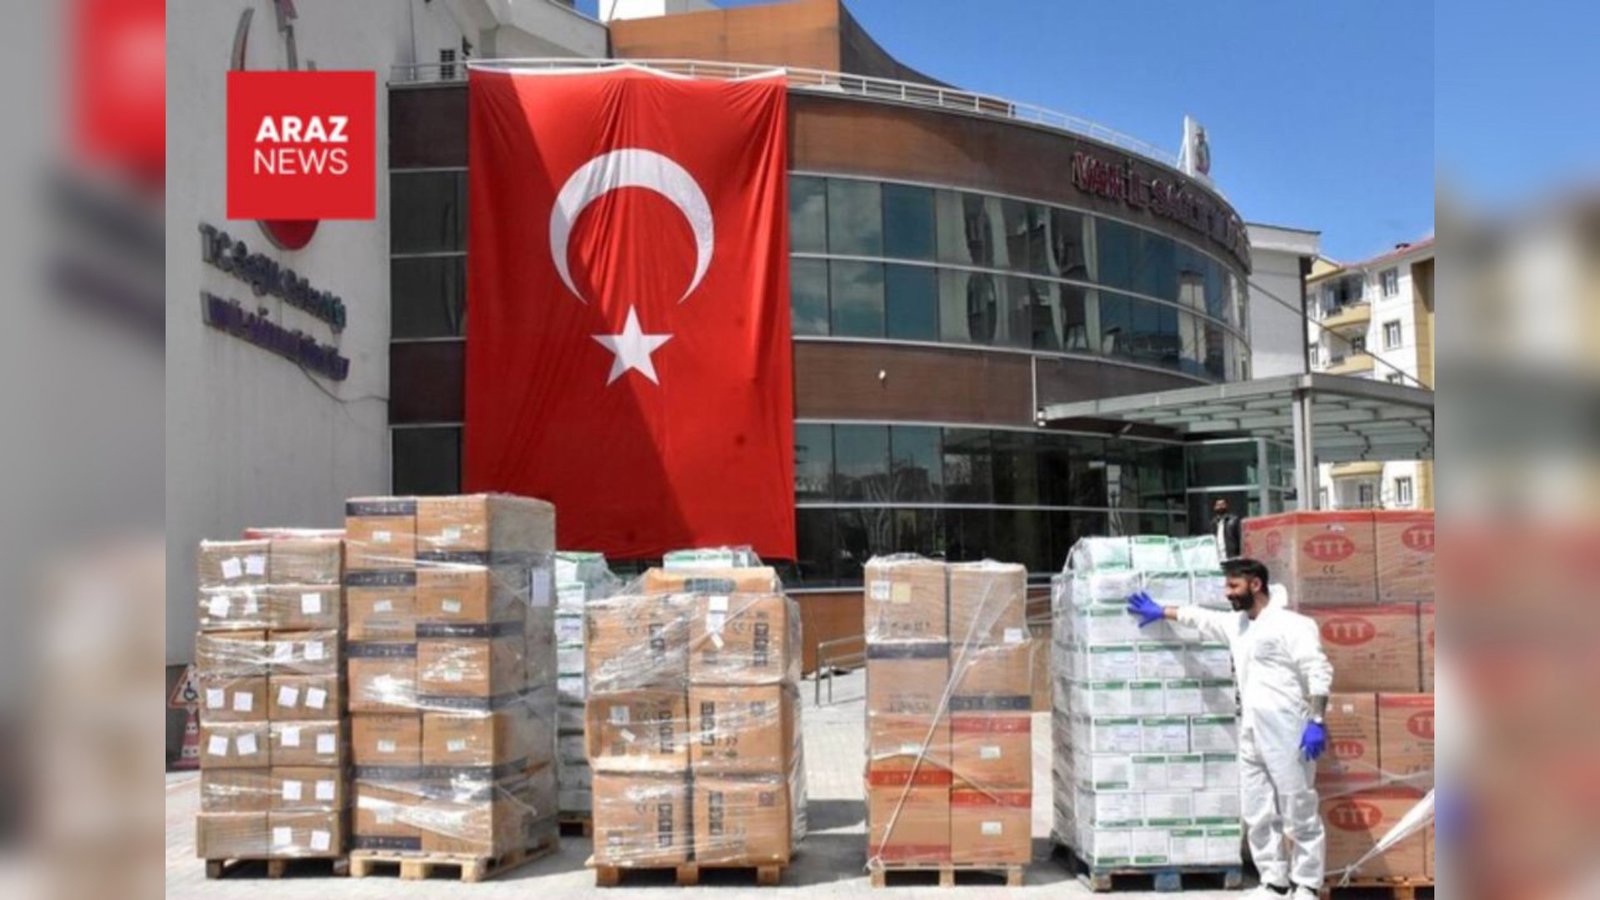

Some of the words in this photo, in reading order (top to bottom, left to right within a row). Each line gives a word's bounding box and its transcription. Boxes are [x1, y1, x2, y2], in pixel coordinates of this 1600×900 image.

[1311, 540, 1346, 557] TTT
[1328, 622, 1367, 639] TTT
[1335, 806, 1374, 825] TTT
